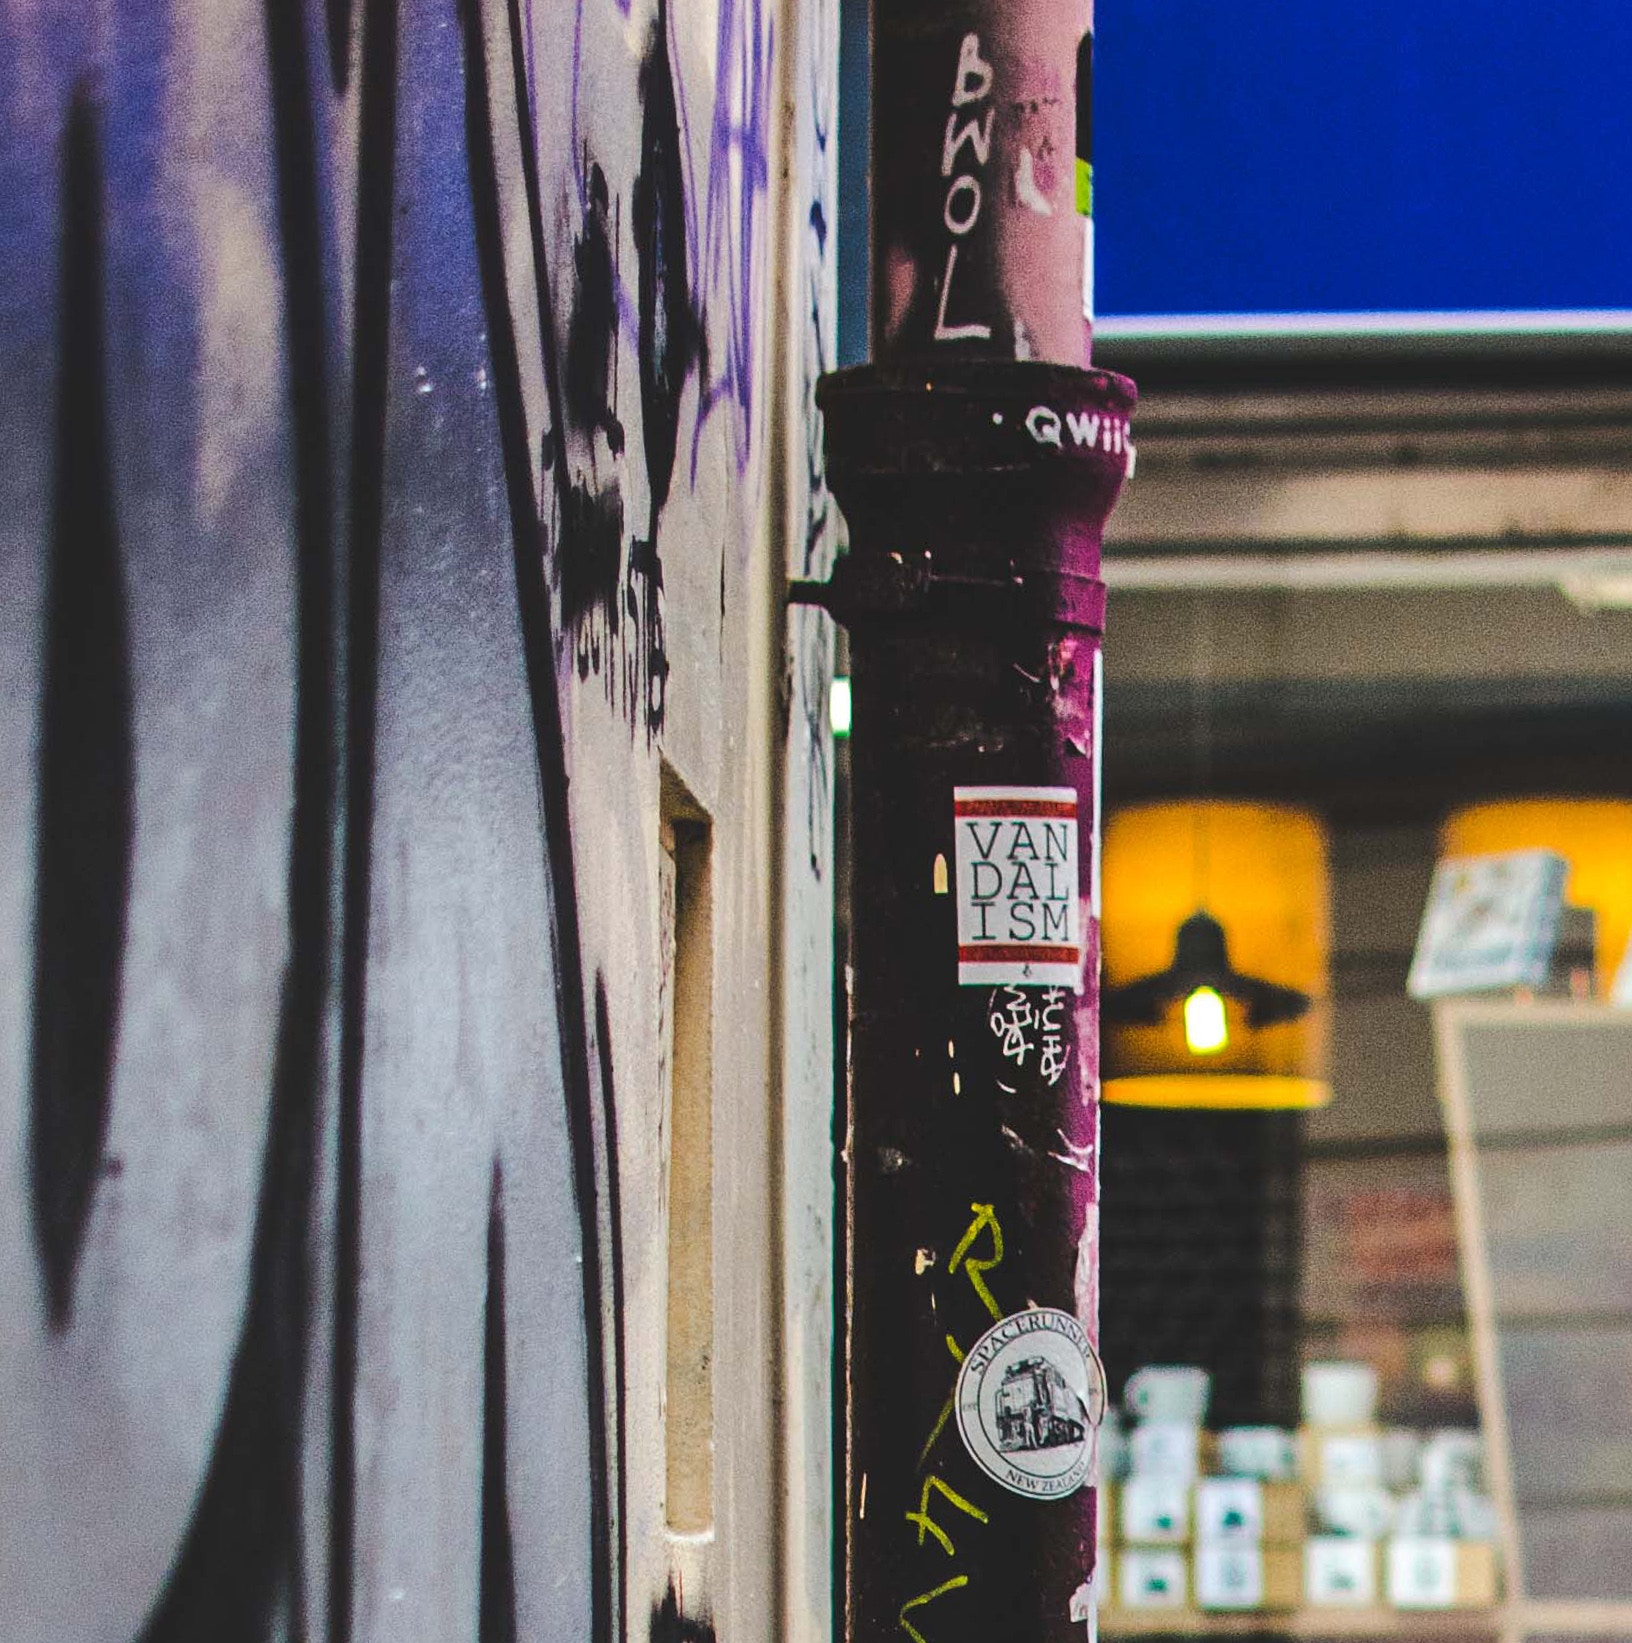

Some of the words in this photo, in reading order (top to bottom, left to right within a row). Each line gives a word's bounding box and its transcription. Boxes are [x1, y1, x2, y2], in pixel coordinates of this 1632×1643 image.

[965, 821, 1069, 861] VAN
[971, 861, 1069, 901] DAL
[971, 901, 1069, 941] ISM
[1004, 1468, 1040, 1491] NEW
